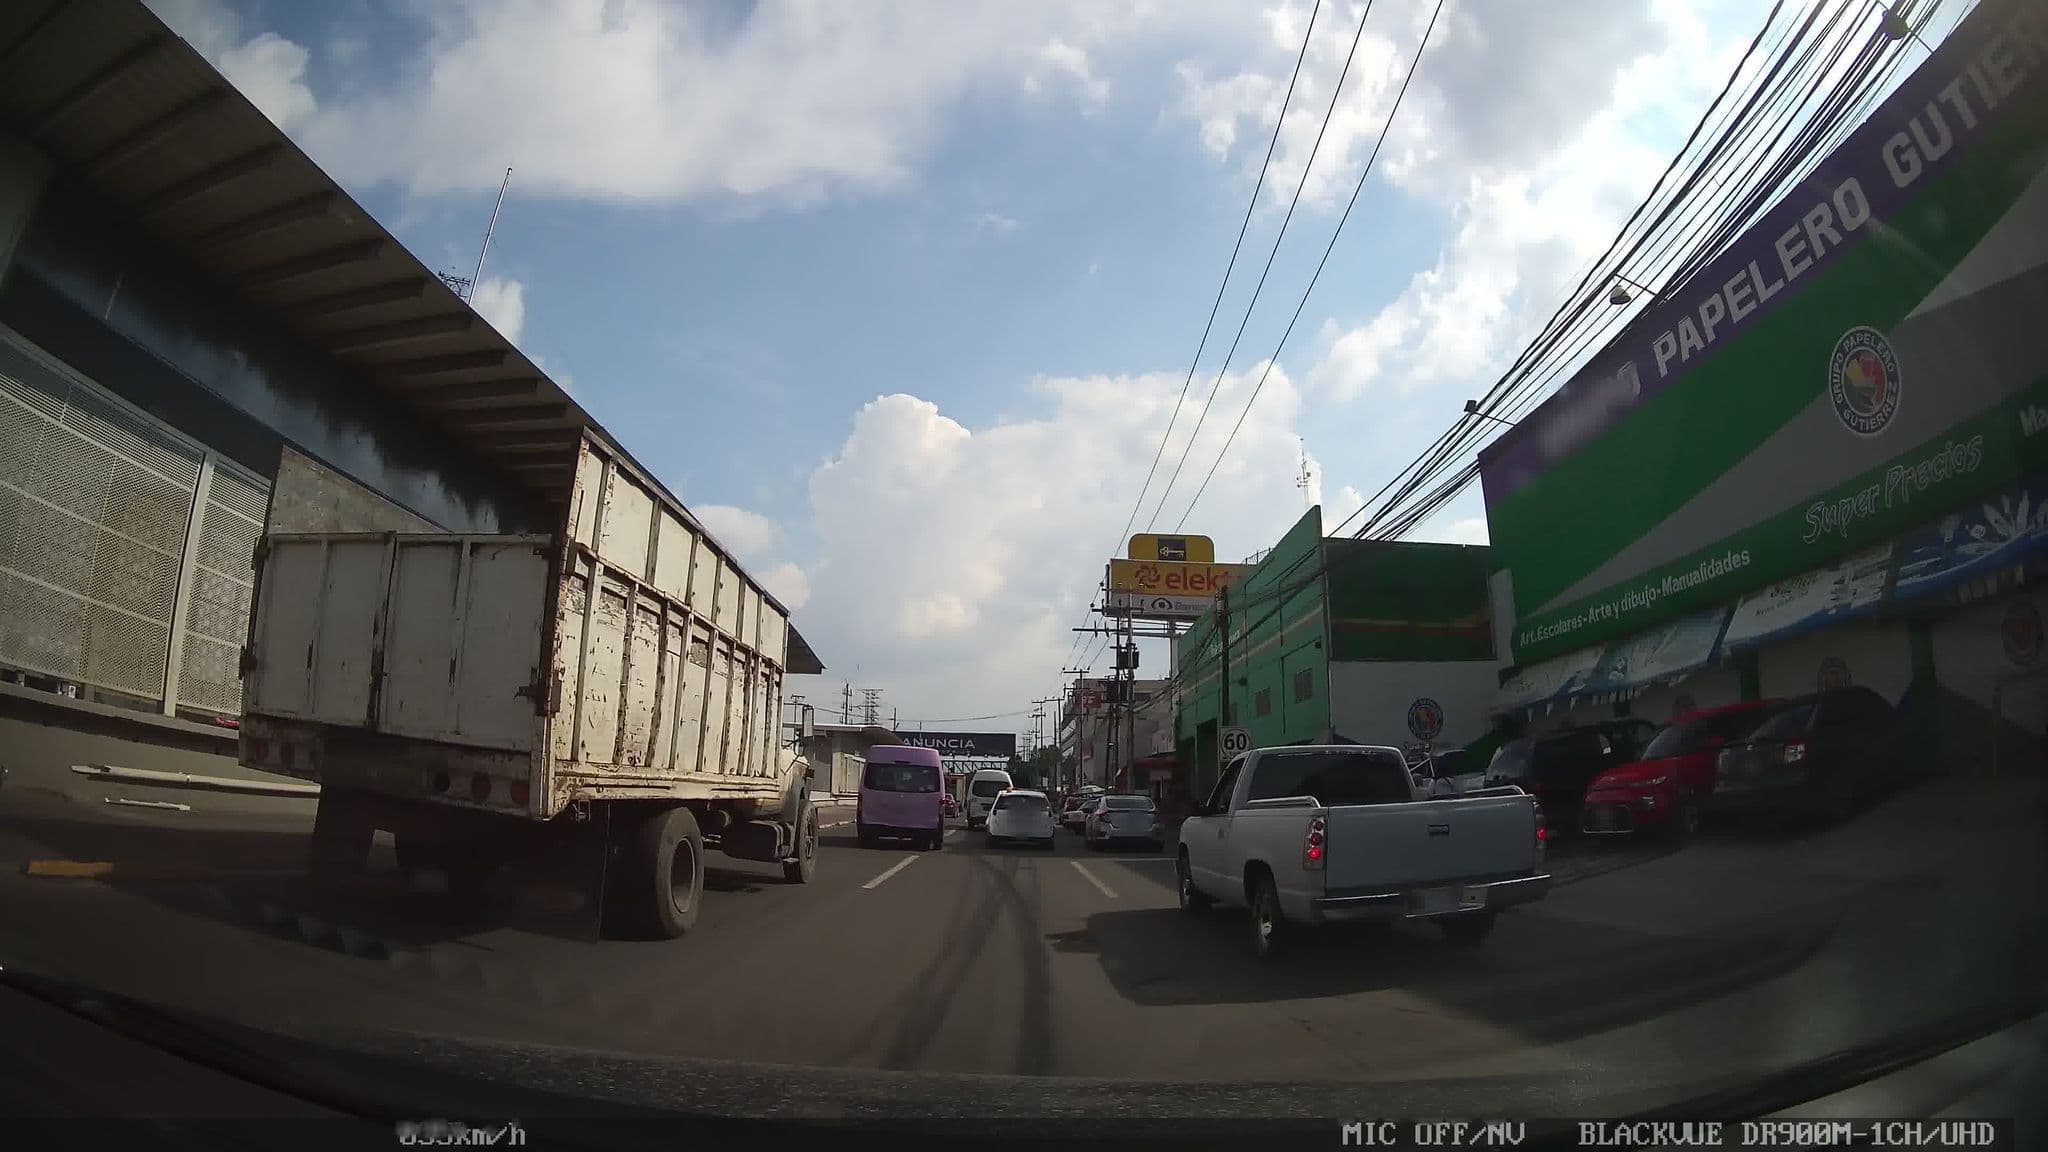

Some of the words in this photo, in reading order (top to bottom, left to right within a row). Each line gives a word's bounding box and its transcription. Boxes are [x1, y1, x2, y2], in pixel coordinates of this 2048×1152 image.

[1652, 176, 1871, 379] PAPELERO
[1831, 352, 1845, 405] GRUPO
[1842, 332, 1897, 374] PAPELERO
[1842, 380, 1898, 431] GUTIERREZ
[1803, 484, 1880, 544] Super
[1884, 434, 1983, 509] Precios
[903, 737, 975, 749] ANUNCIA
[1224, 733, 1247, 750] 60
